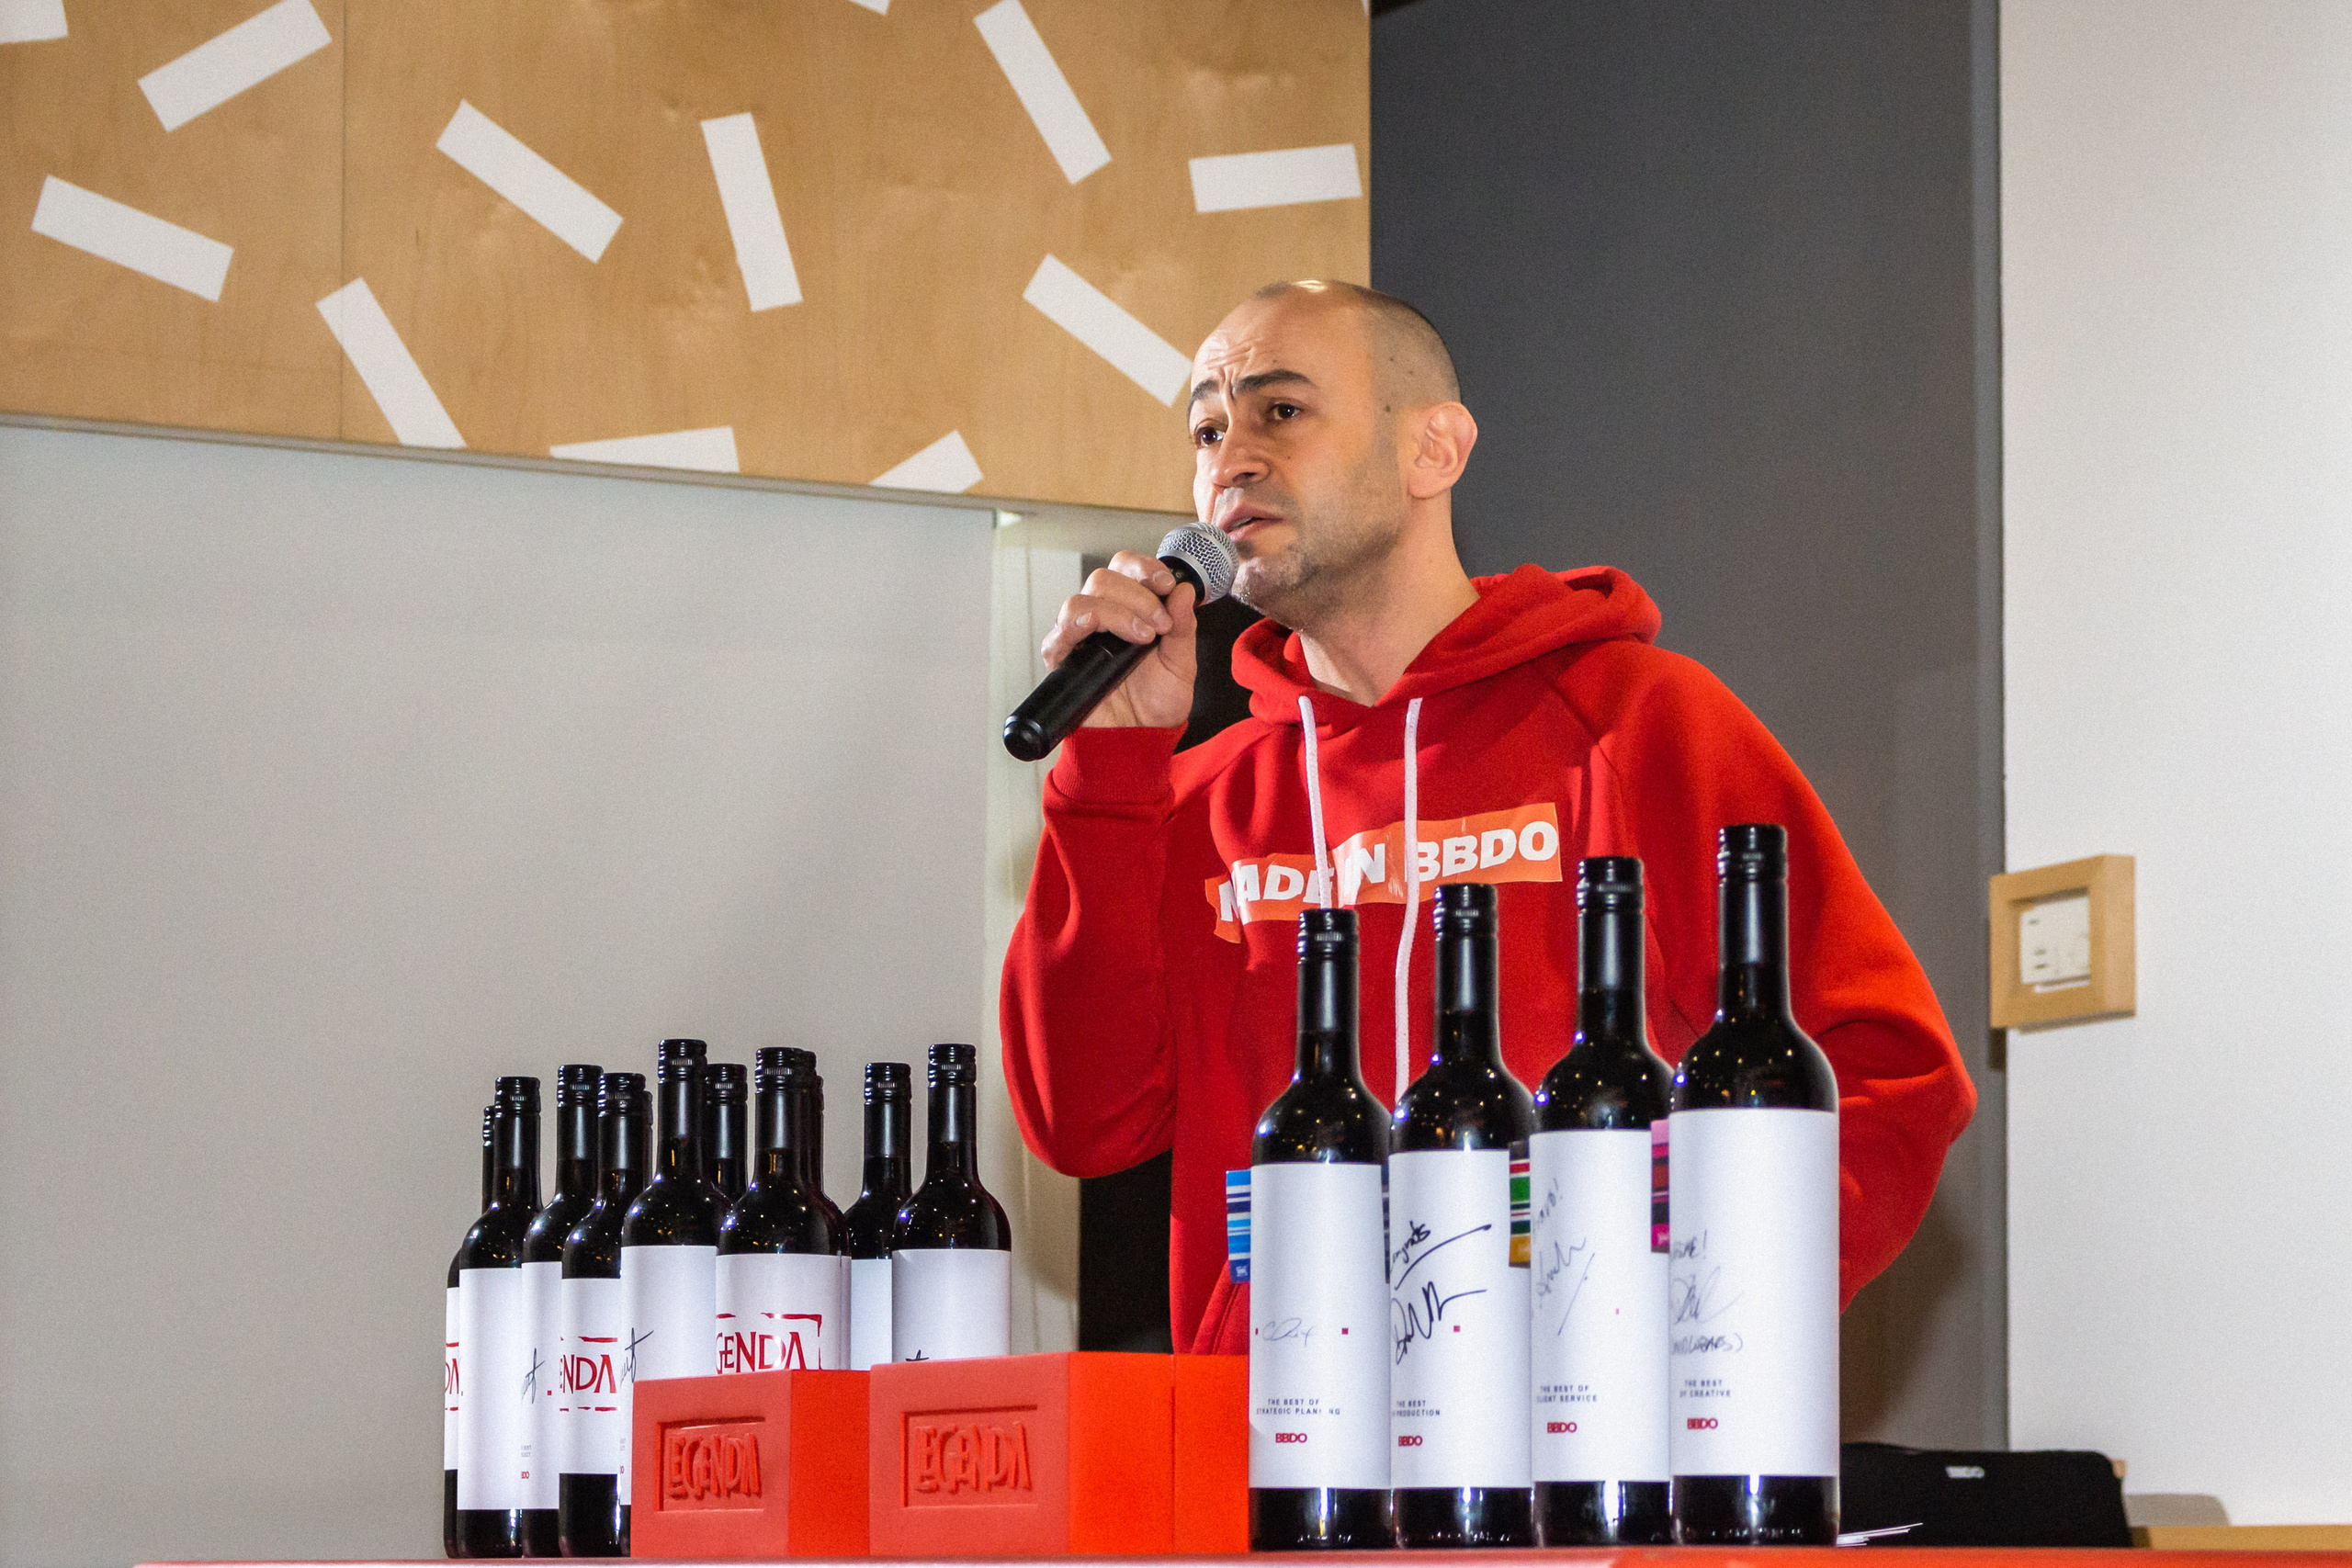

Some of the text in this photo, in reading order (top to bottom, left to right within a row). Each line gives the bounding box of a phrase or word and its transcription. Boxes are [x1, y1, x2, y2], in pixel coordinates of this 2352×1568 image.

[1404, 820, 1558, 883] BBDO
[560, 1354, 617, 1394] NDA
[1554, 1384, 1574, 1393] BEST
[1577, 1384, 1589, 1393] OF
[1701, 1380, 1723, 1388] BEST
[1560, 1394, 1597, 1404] SERVICE
[1690, 1389, 1731, 1398] CREATIVE
[1268, 1398, 1280, 1406] THE
[1283, 1398, 1305, 1406] BEST
[1408, 1399, 1426, 1407] BEST
[1546, 1422, 1577, 1434] BBDO
[1686, 1417, 1719, 1430] BBDO
[1274, 1432, 1308, 1444] BBDO
[1397, 1435, 1424, 1448] BBDO
